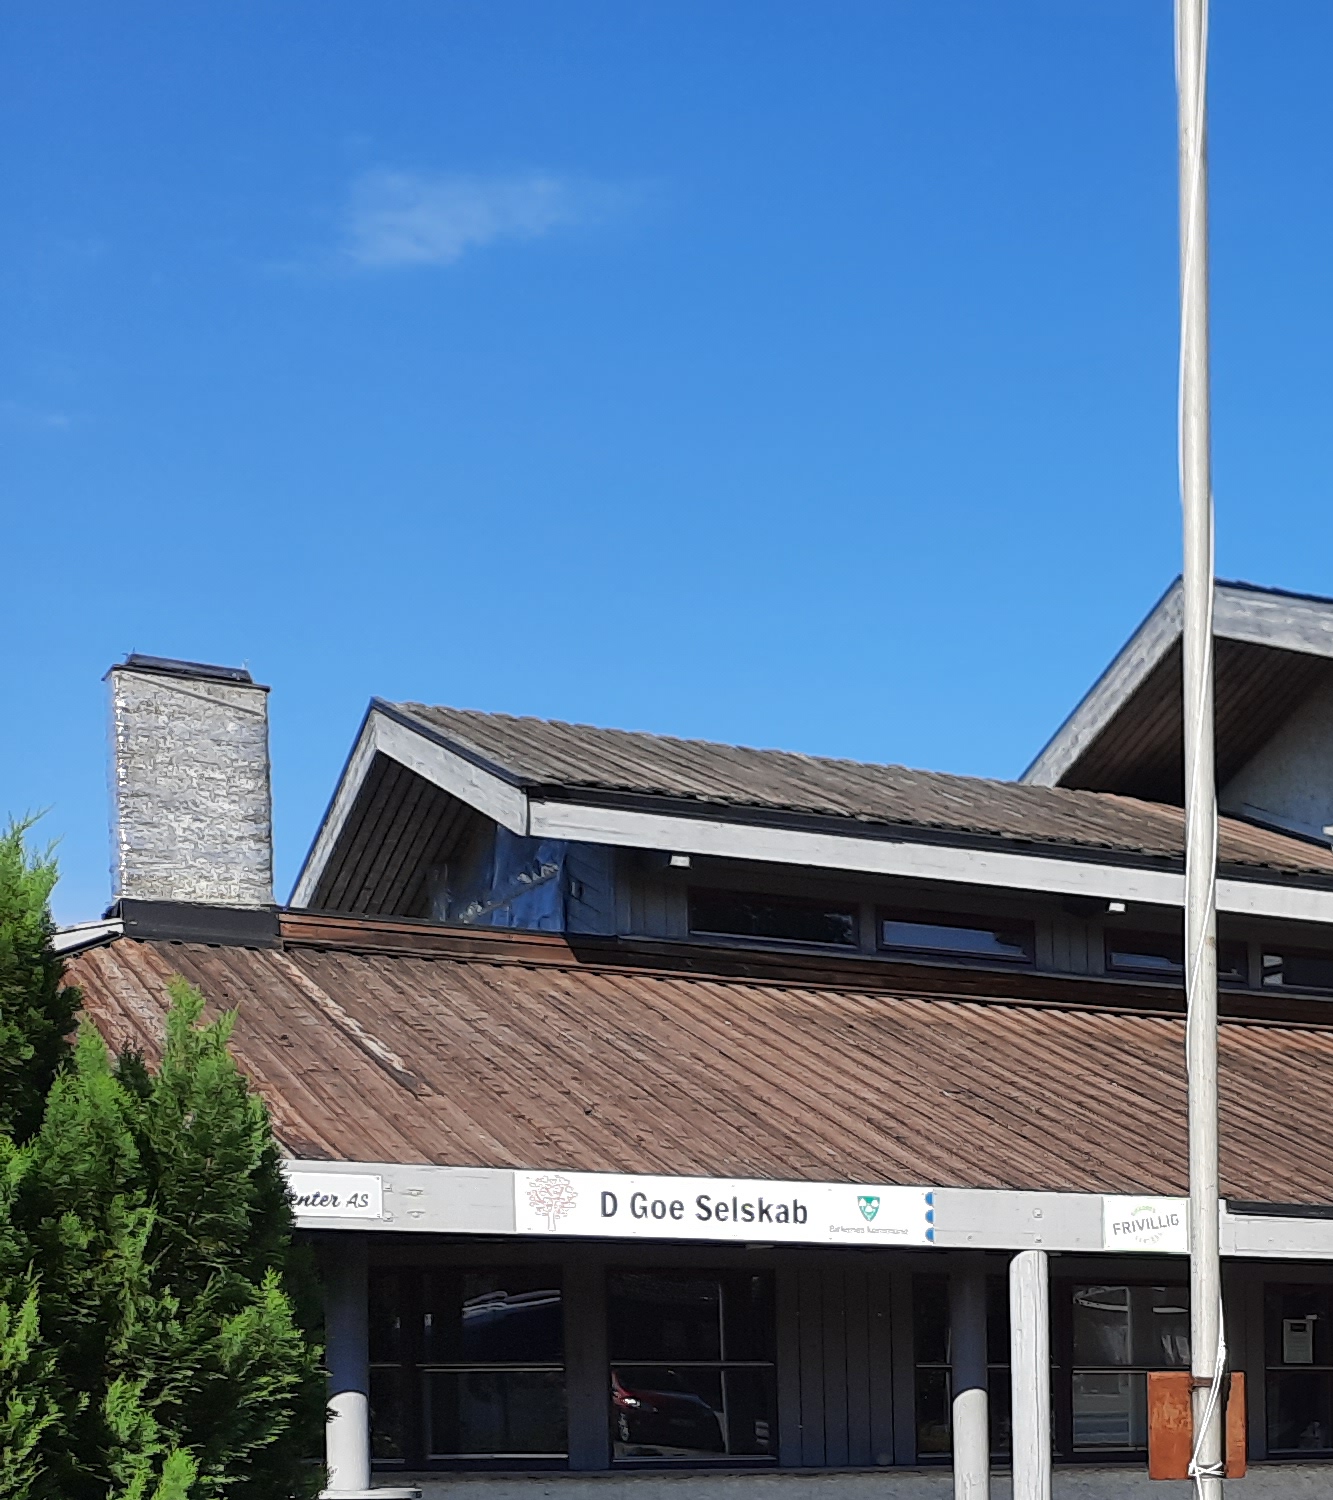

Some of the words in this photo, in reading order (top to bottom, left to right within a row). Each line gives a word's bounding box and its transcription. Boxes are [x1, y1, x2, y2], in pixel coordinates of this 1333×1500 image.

[288, 1191, 341, 1208] enter
[346, 1193, 369, 1208] AS
[600, 1191, 618, 1218] D
[630, 1191, 685, 1220] Goe
[695, 1194, 808, 1224] Selskab
[1112, 1213, 1180, 1236] FRIVILLIG
